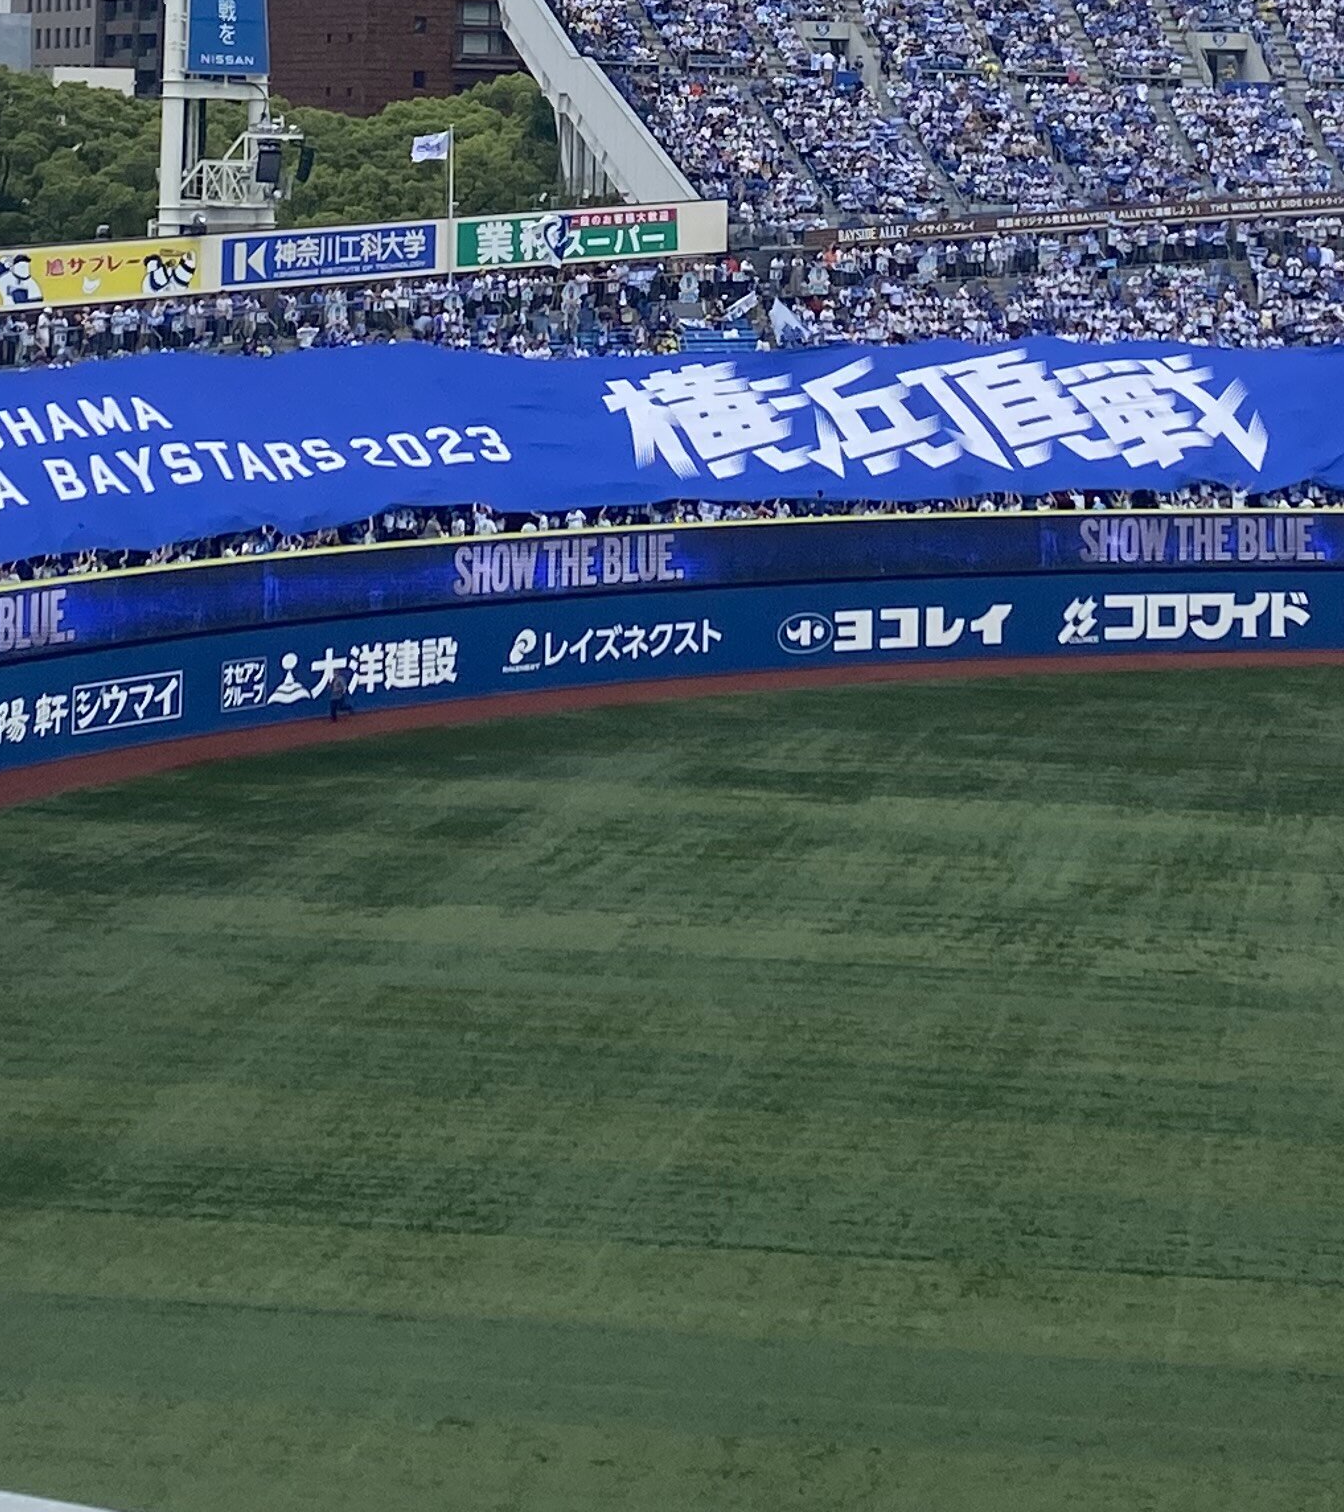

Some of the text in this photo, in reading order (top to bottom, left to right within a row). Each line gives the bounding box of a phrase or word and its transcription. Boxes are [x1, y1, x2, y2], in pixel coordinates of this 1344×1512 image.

[199, 52, 255, 66] NISSAN
[1210, 201, 1229, 213] THE
[1231, 199, 1257, 211] WING
[1259, 198, 1278, 209] BAY
[1280, 197, 1302, 209] SIDE
[273, 227, 426, 267] 神奈川工科大学
[838, 227, 877, 243] BAYSIDE
[879, 225, 909, 241] ALLEY
[45, 253, 144, 277] 鳩サブレー
[47, 435, 347, 502] BAYSTARS
[349, 424, 512, 470] 2023
[1079, 517, 1326, 564] SHOW THE BLUE.
[454, 533, 685, 596] SHOW THE BLUE.
[833, 604, 1013, 652] ヨコレイ
[1104, 592, 1311, 642] コロワイド
[544, 618, 722, 667] レイズネクスト
[223, 661, 266, 686] オセアン
[310, 637, 458, 699] 大洋建設
[75, 677, 179, 731] シウマイ
[223, 683, 265, 709] グループ
